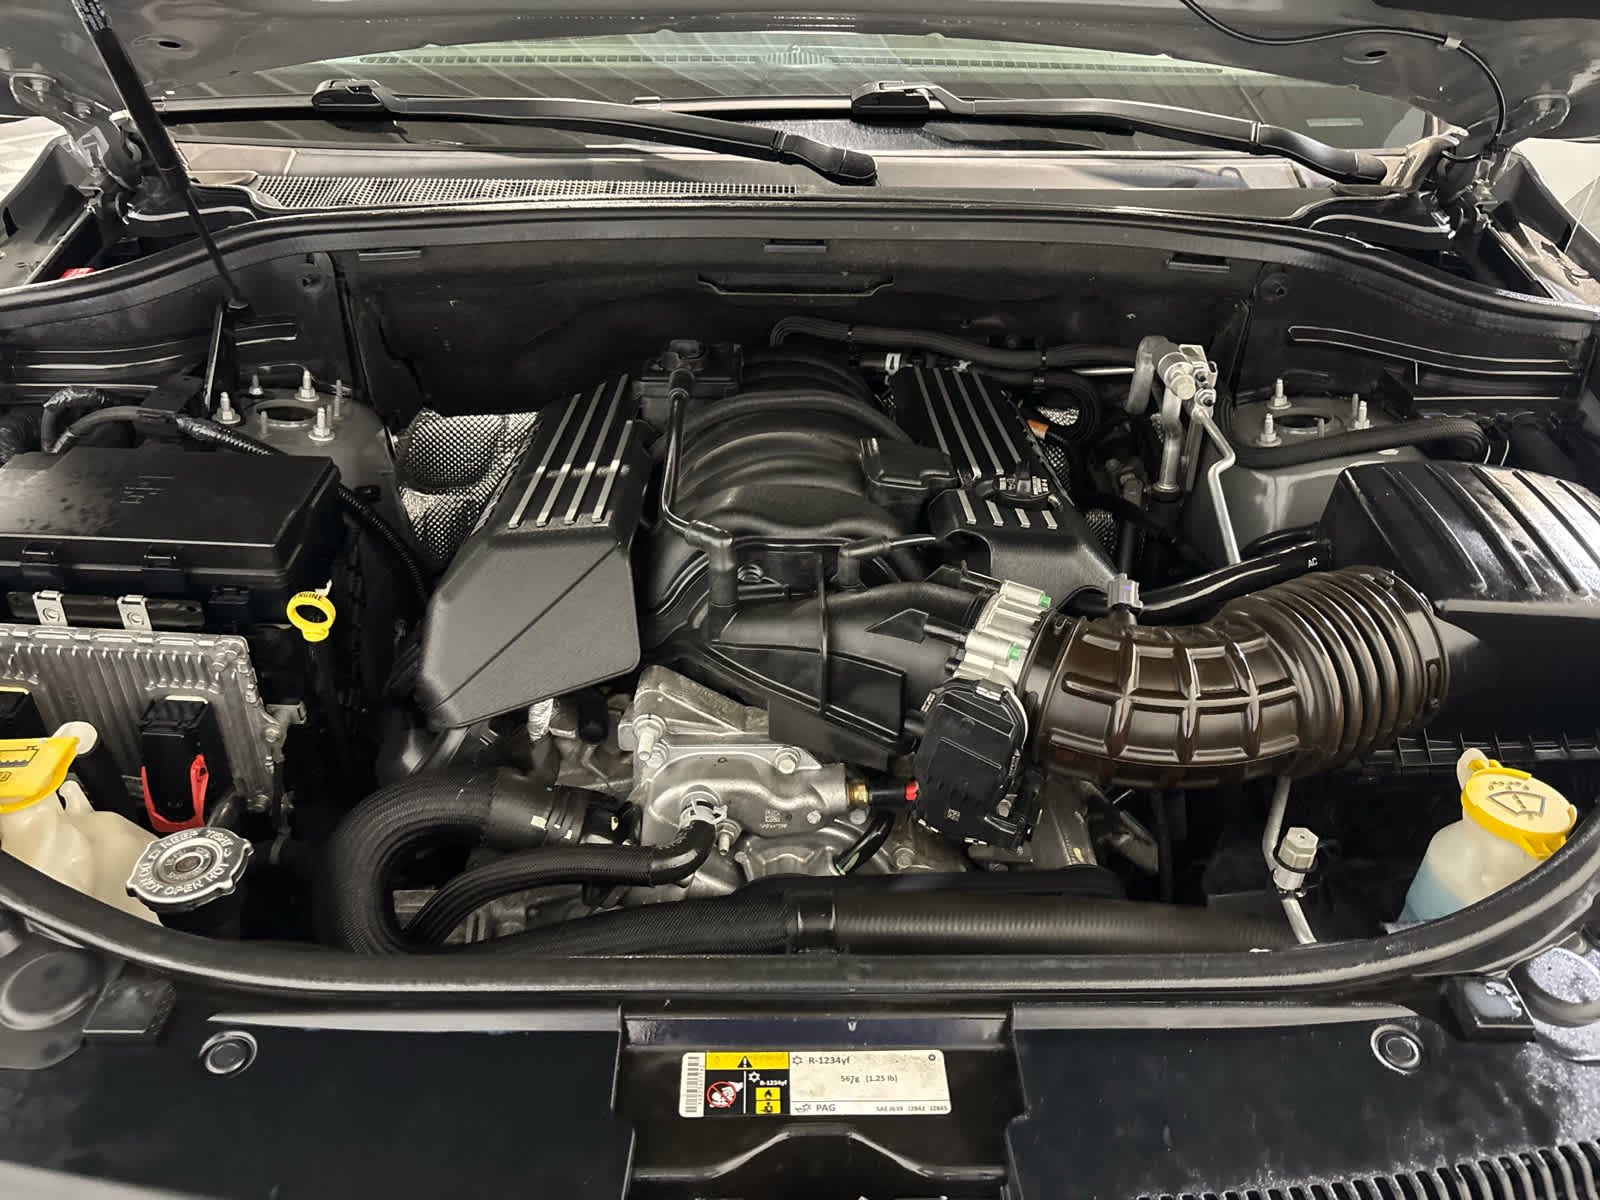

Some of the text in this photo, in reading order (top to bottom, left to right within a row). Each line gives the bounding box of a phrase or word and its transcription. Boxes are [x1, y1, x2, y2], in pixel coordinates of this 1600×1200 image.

[1307, 556, 1318, 568] AC
[164, 880, 204, 896] OPEN
[205, 863, 230, 882] HOT
[808, 1055, 850, 1066] R-1234yf
[840, 1075, 860, 1084] 567g
[816, 1103, 836, 1112] PAG
